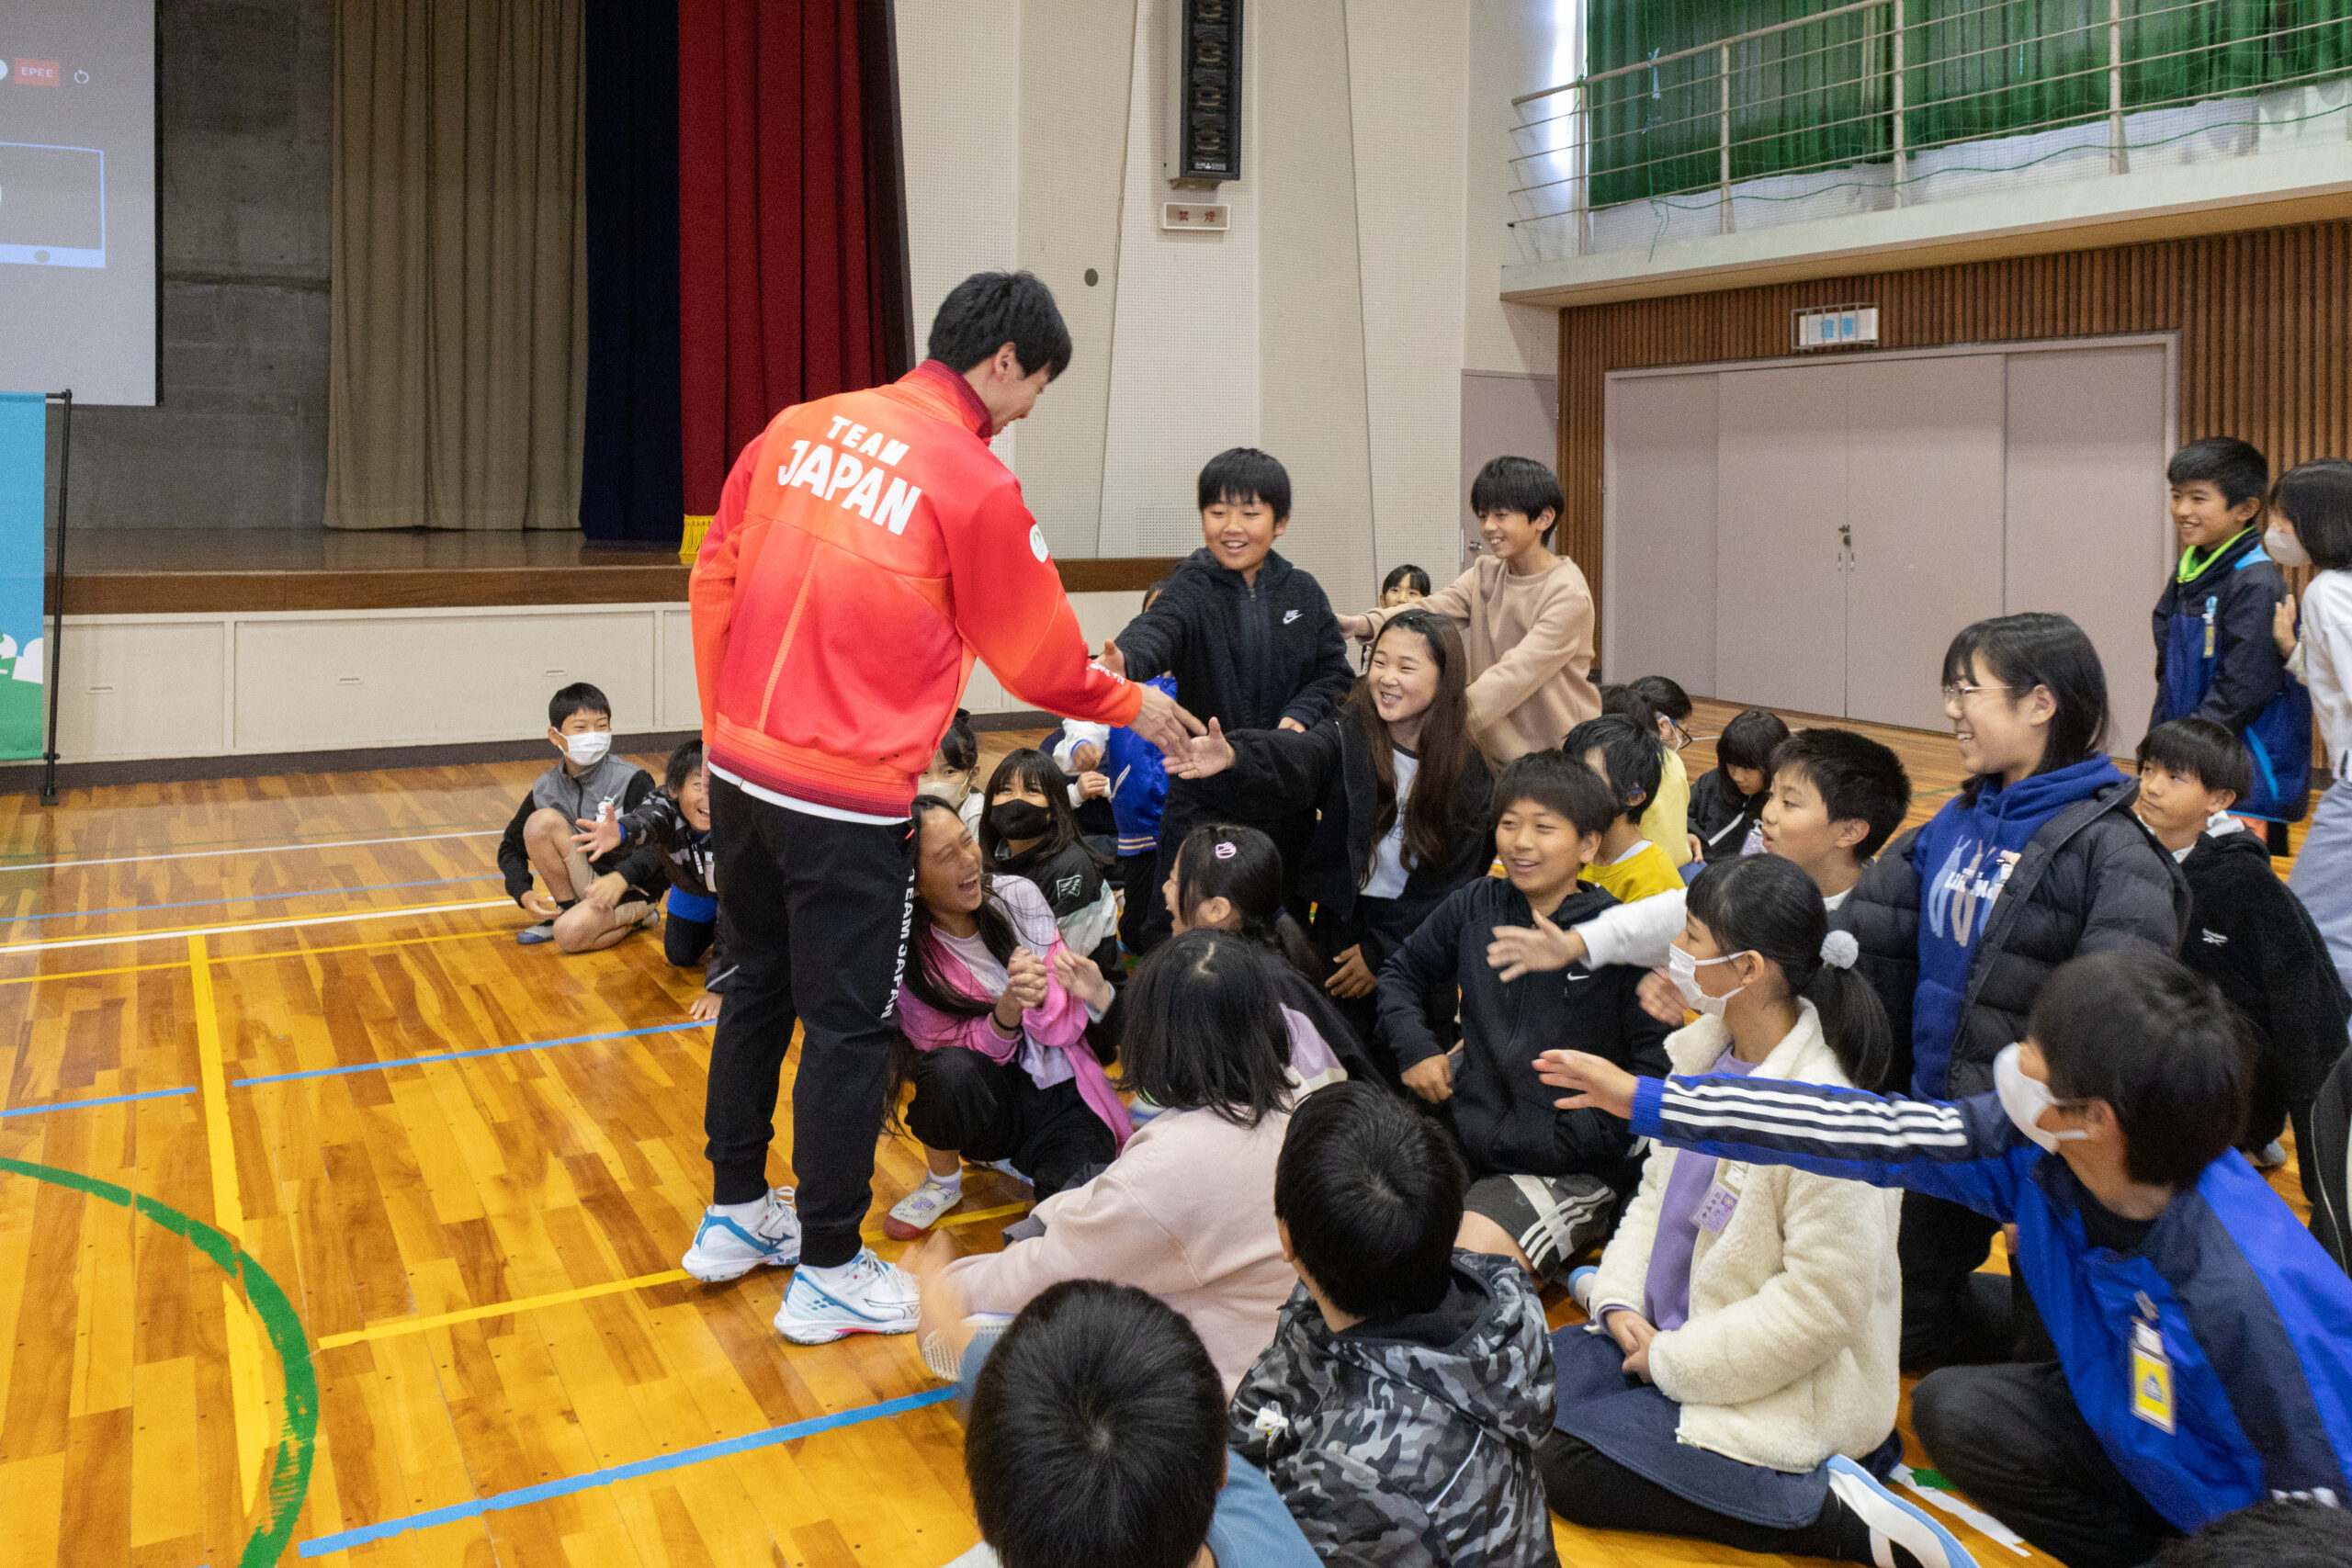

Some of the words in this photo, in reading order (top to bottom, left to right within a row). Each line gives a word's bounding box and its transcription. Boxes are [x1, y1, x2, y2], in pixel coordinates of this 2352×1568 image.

[21, 66, 52, 78] EPEE
[826, 414, 910, 467] TEAM
[777, 439, 922, 536] JAPAN
[899, 868, 915, 939] TEAM
[880, 943, 908, 1019] JAPAN
